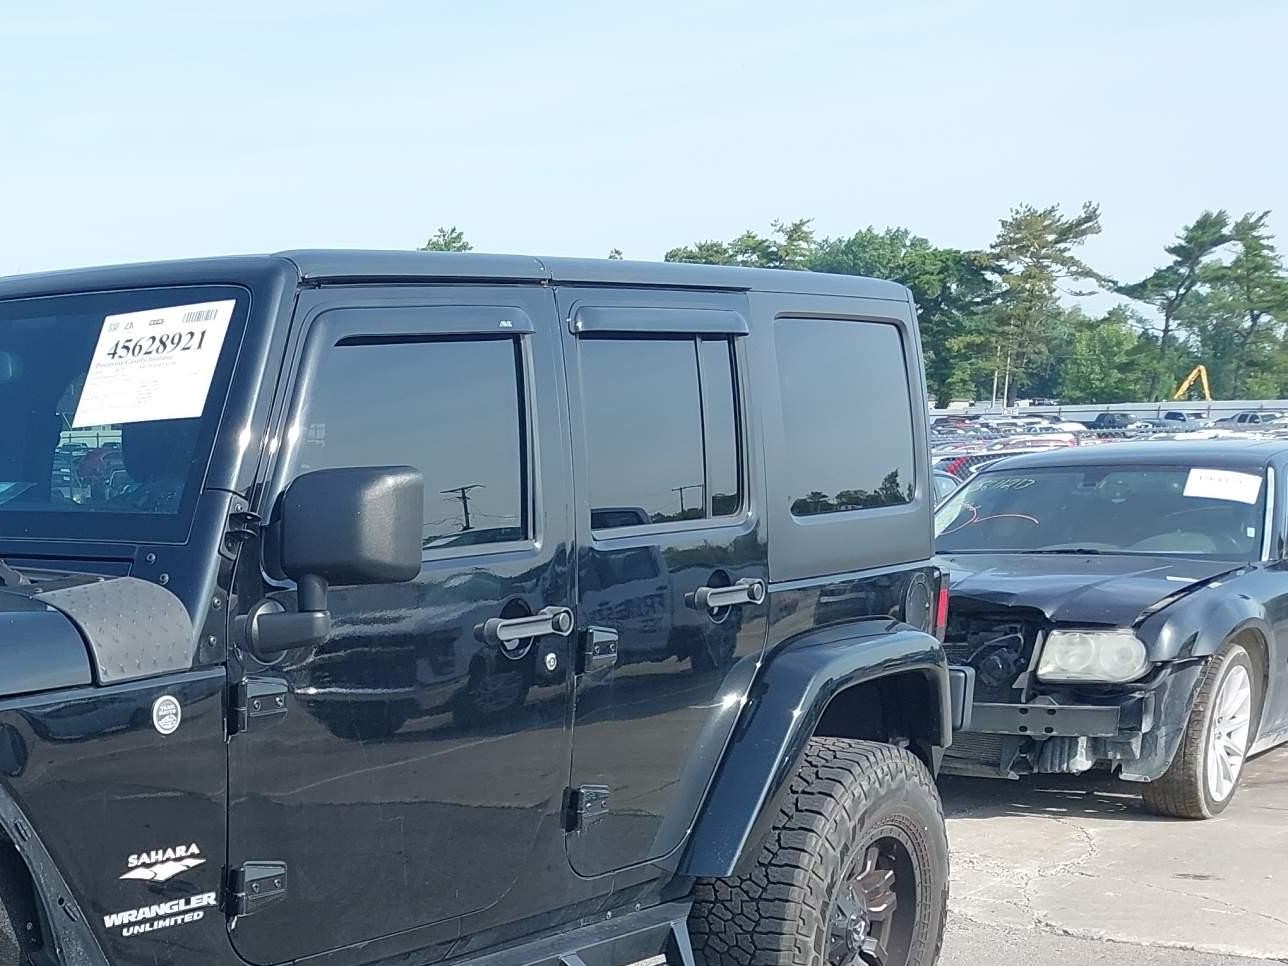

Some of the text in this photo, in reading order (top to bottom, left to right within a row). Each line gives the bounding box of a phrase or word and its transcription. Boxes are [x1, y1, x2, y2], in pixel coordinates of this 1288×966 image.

[107, 329, 207, 359] 45628921
[127, 843, 200, 867] SAHARA
[103, 891, 217, 928] WRANGLER
[122, 911, 205, 937] UNLIMITED
